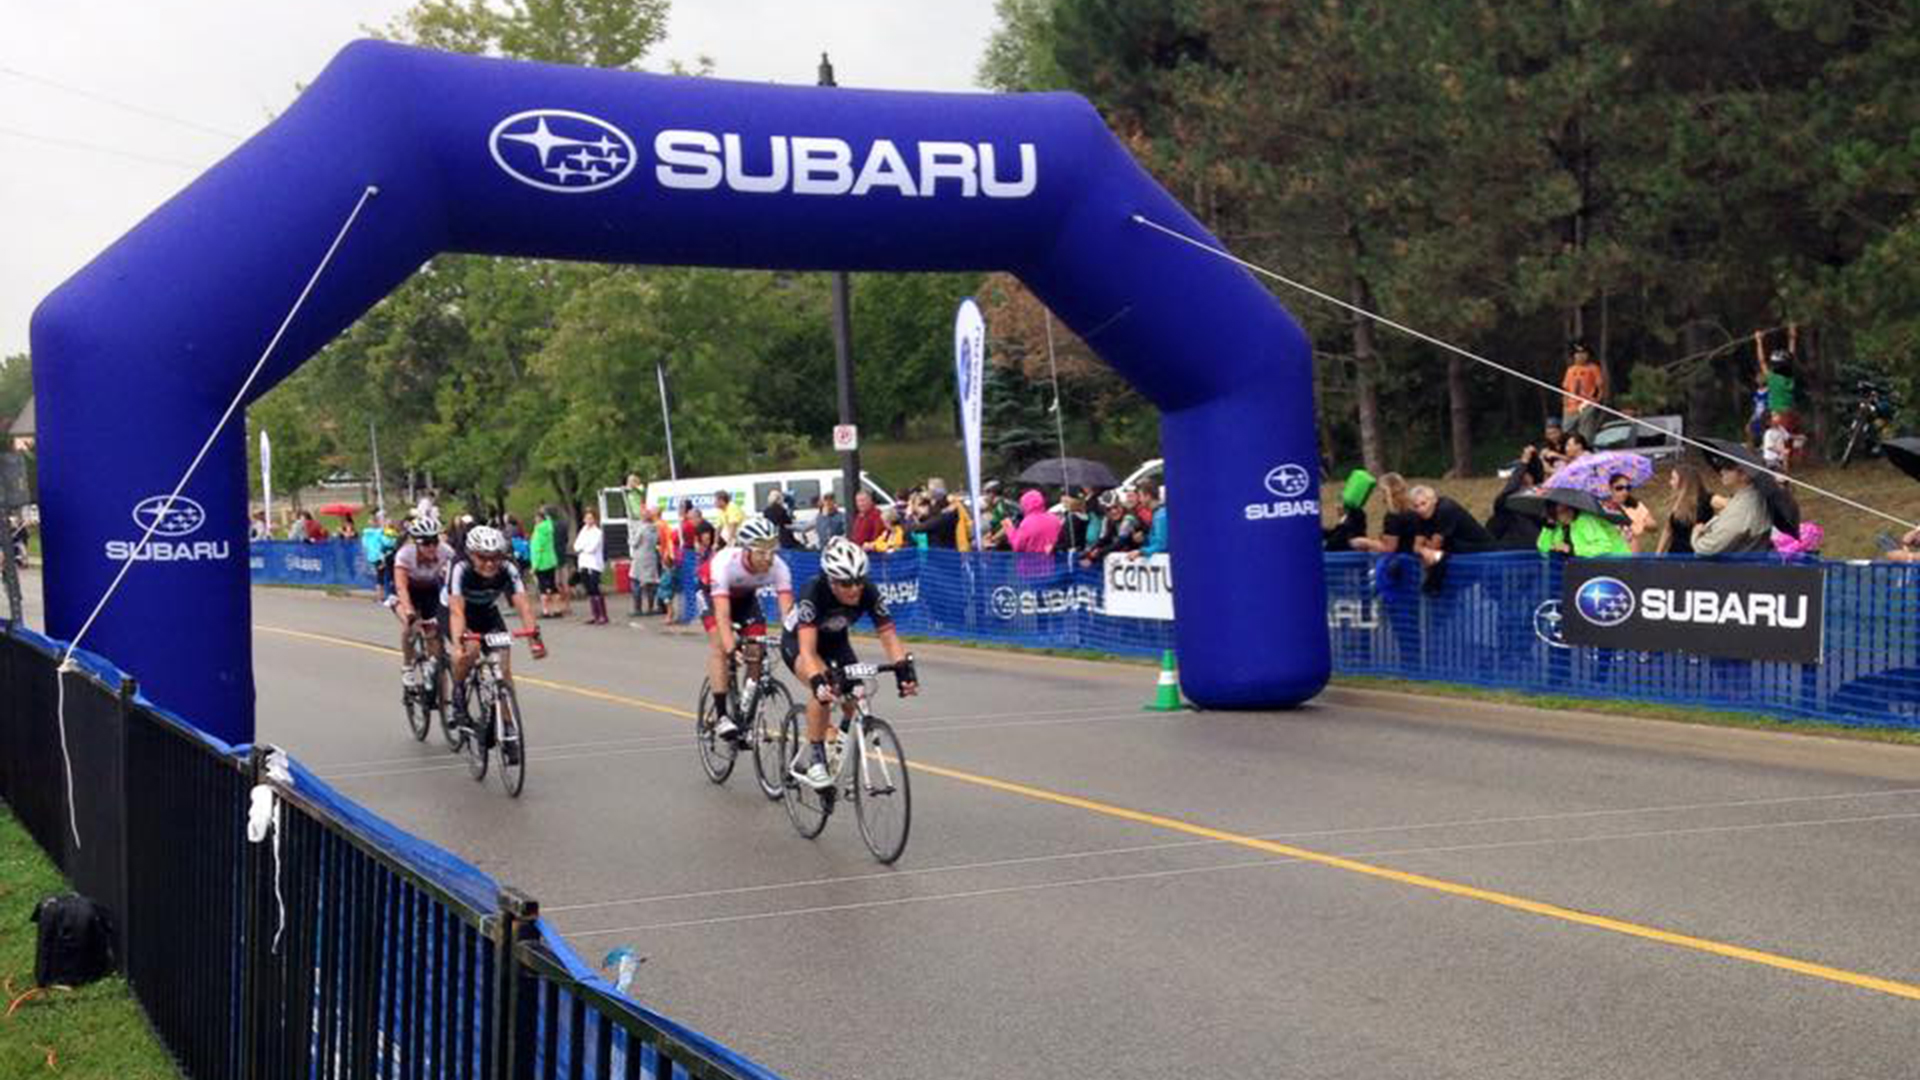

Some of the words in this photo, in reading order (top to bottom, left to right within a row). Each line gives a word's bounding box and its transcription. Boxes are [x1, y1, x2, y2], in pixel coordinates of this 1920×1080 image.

[654, 130, 1038, 198] SUBARU
[105, 540, 230, 561] SUBARU
[1640, 588, 1809, 629] SUBARU
